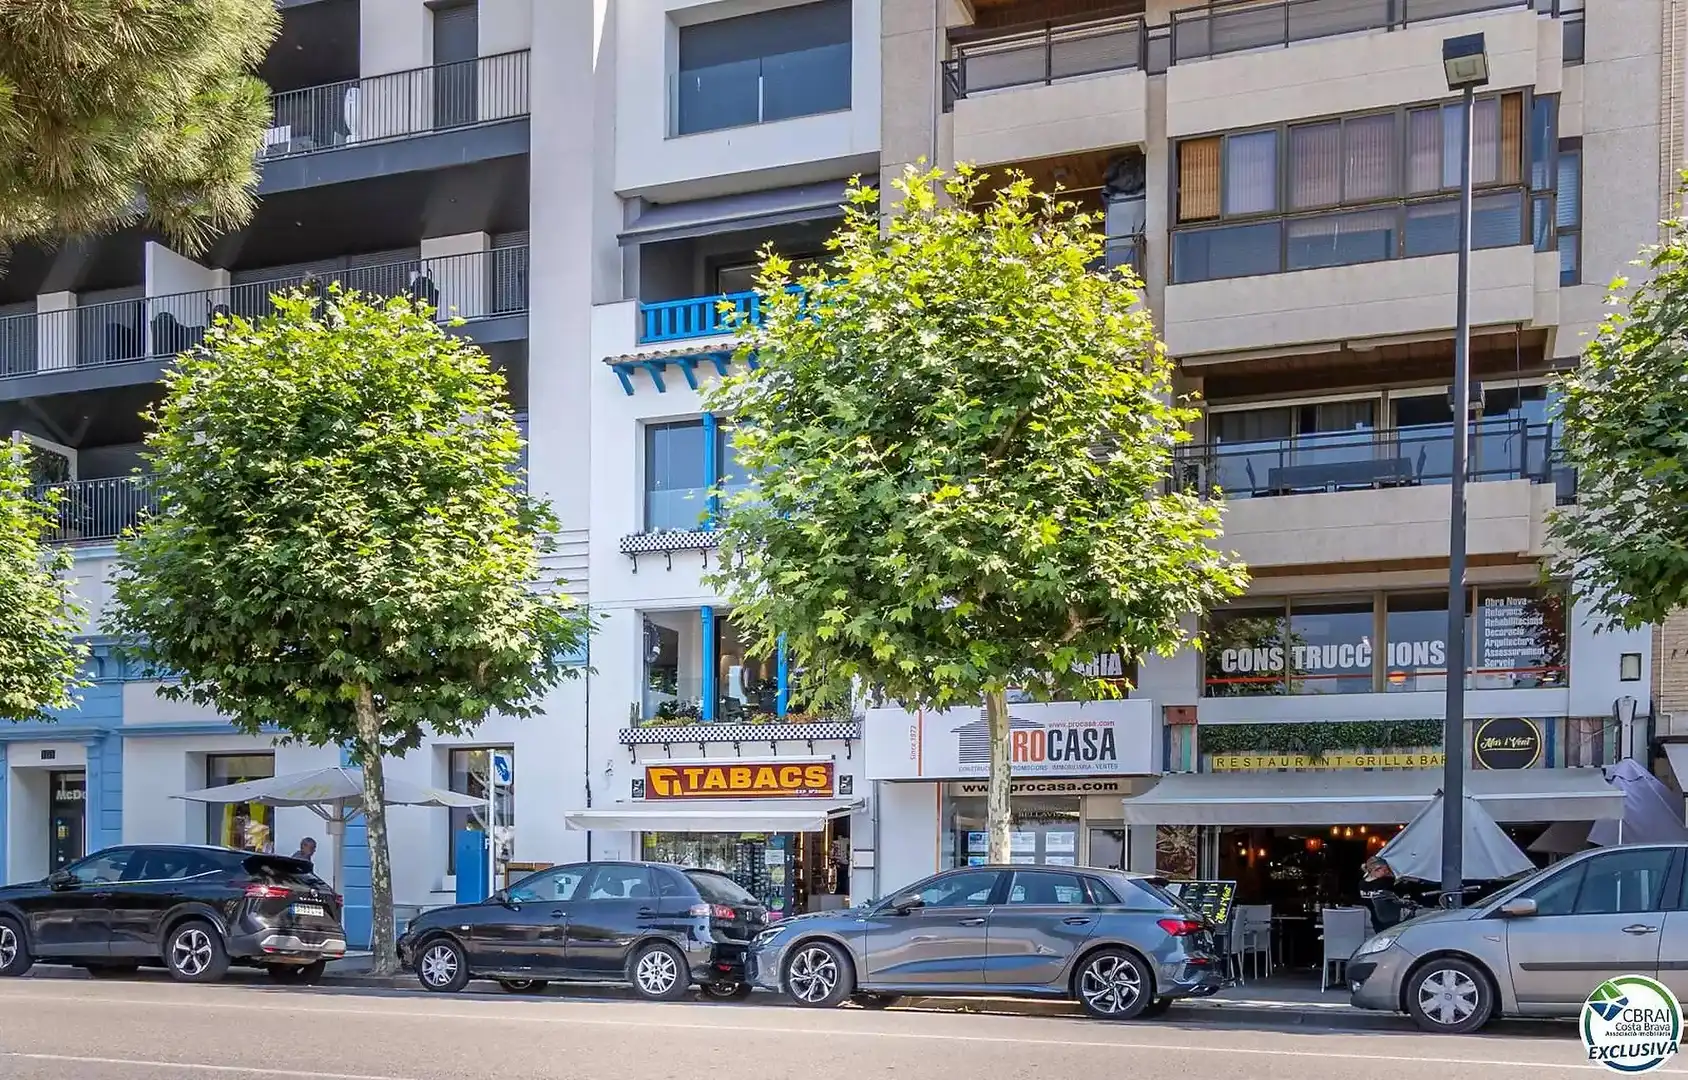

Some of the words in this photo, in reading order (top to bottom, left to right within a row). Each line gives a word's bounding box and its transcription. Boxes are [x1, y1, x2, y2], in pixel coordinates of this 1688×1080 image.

[1485, 598, 1504, 606] Obra
[1506, 597, 1527, 606] Nova
[1012, 728, 1117, 762] ROCASA
[683, 766, 827, 790] TABACS
